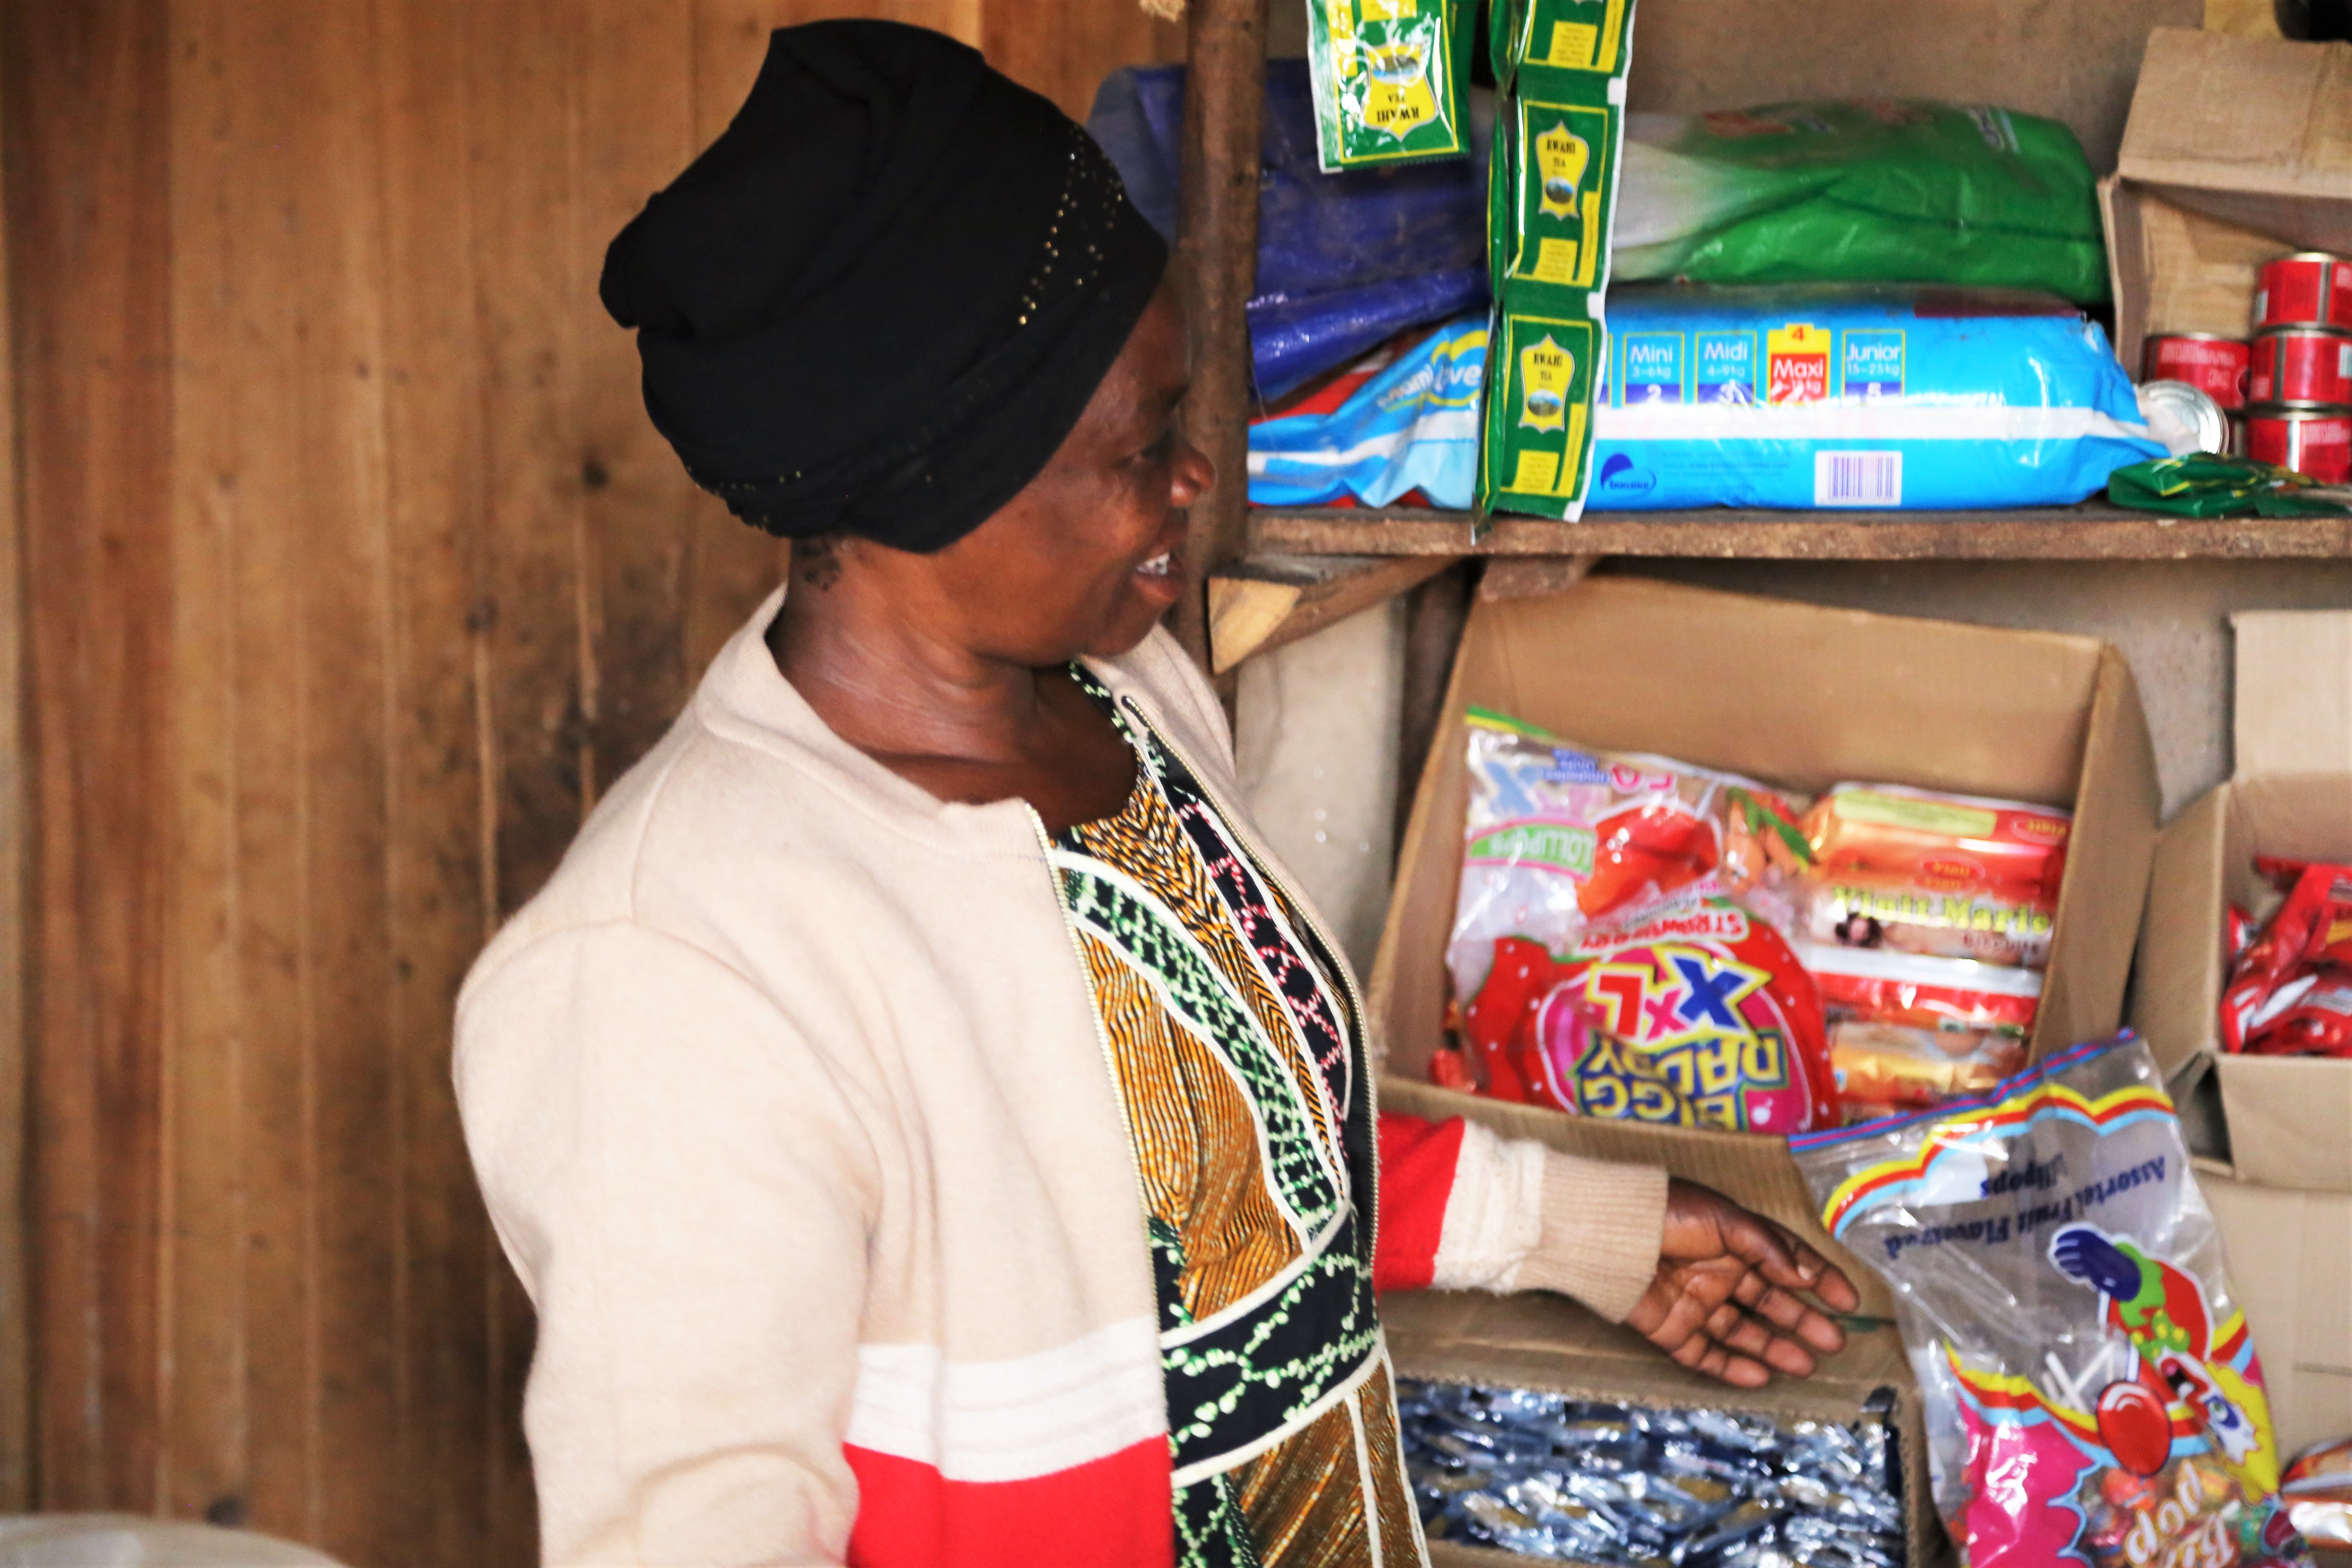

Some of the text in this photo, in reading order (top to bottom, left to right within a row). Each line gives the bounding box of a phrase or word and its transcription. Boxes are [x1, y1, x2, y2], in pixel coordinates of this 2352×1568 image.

[1791, 327, 1804, 341] 4
[1630, 344, 1673, 363] Mini
[1704, 341, 1748, 361] Midi
[1845, 343, 1901, 362] Junior
[1773, 358, 1824, 379] Maxi
[1489, 828, 1592, 866] LOLLIPOPS
[1943, 897, 2051, 935] Marie
